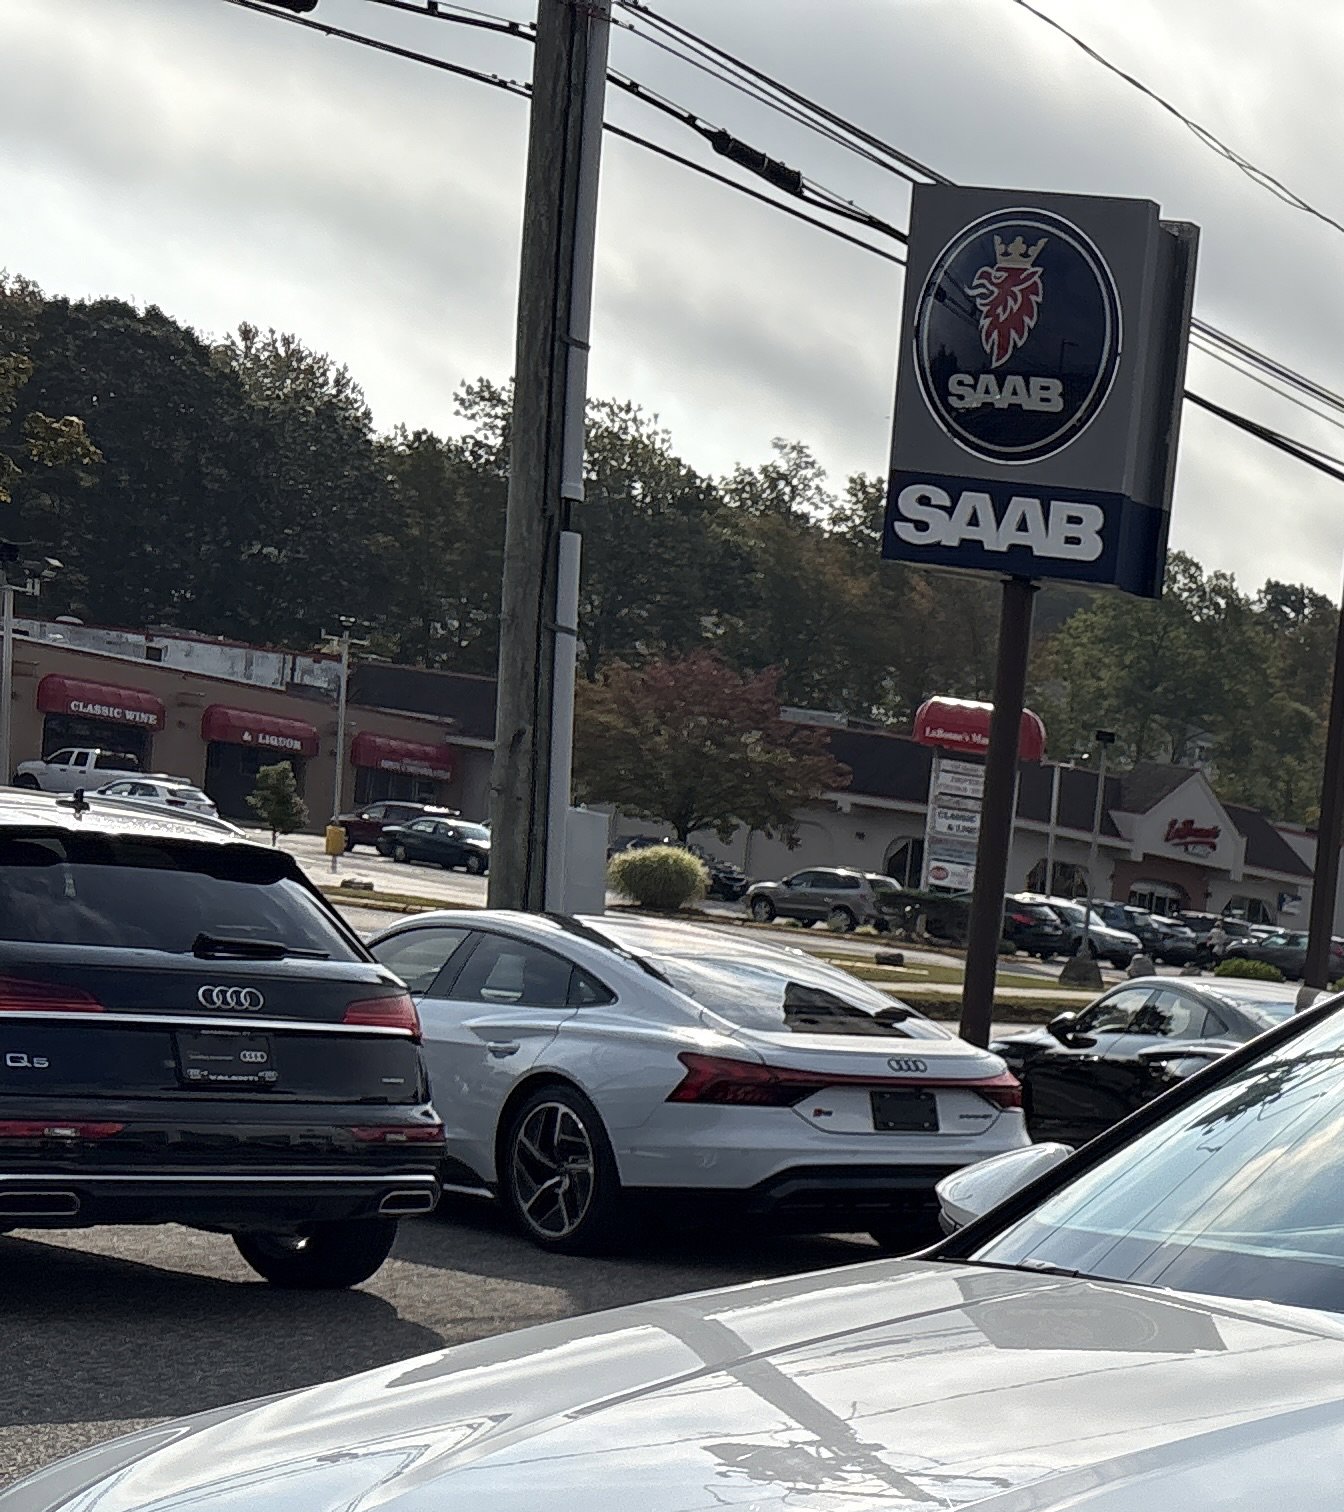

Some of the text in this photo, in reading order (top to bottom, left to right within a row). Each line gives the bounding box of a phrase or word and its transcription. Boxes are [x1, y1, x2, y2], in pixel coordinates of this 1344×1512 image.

[948, 373, 1064, 413] SAAB
[894, 484, 1104, 562] SAAB
[70, 701, 158, 725] CLASSIC WINE
[6, 1053, 49, 1067] Q5
